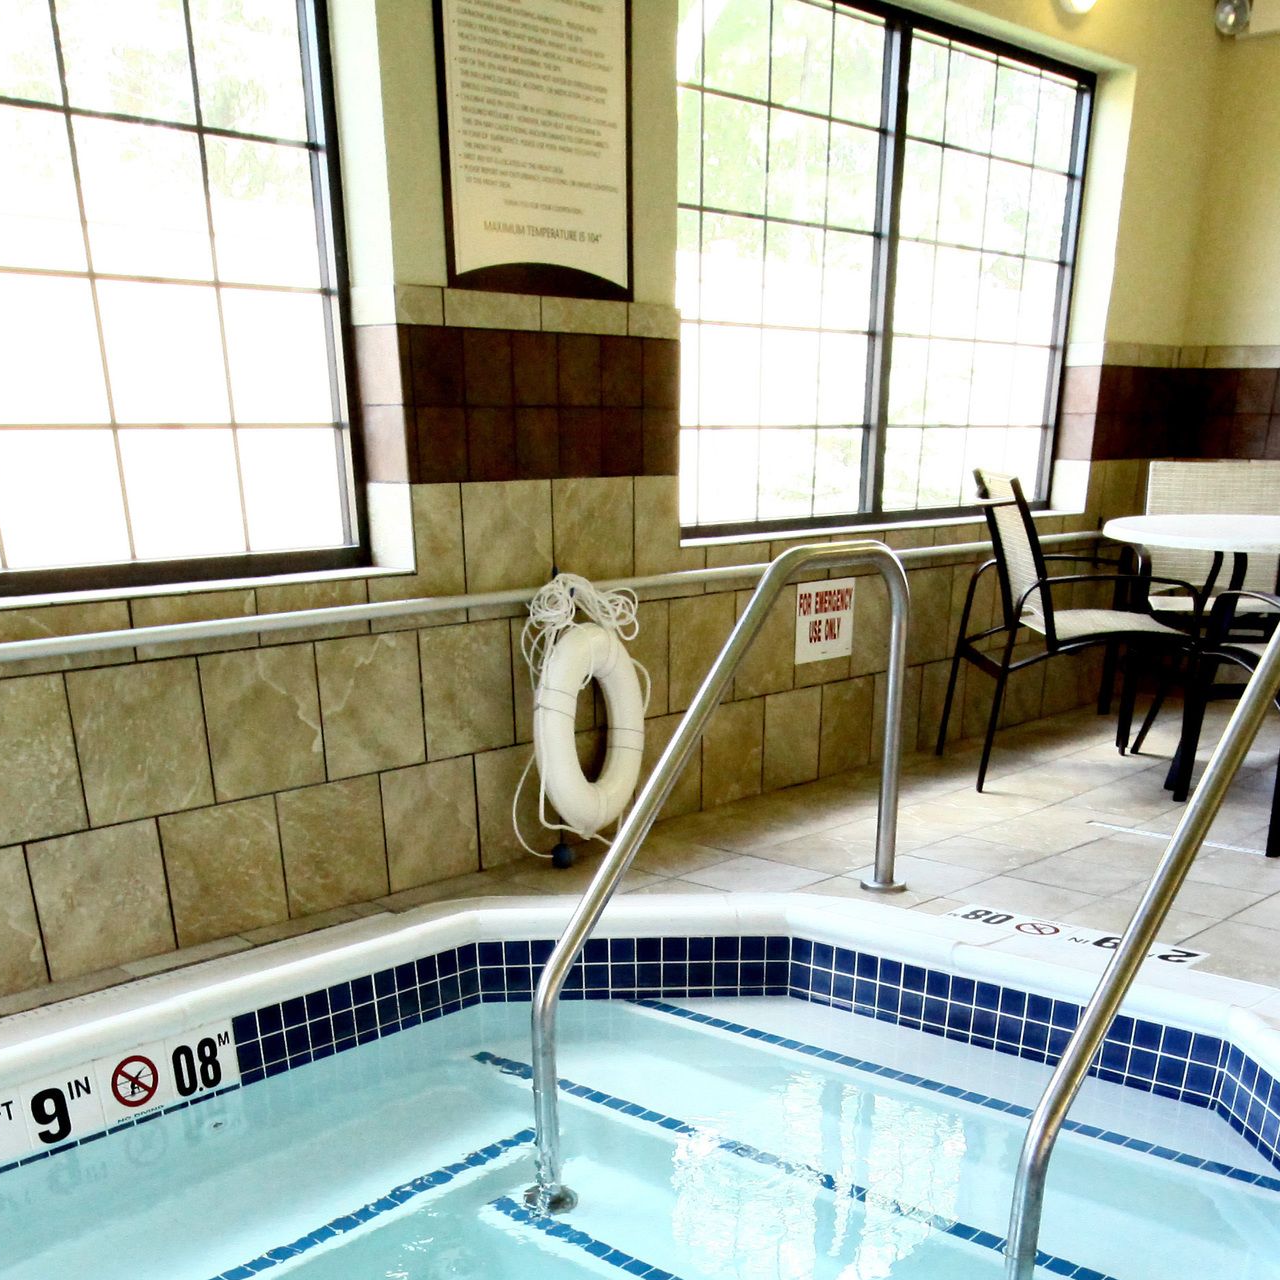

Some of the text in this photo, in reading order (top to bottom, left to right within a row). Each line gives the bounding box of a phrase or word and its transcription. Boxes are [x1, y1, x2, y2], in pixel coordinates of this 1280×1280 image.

[483, 220, 525, 235] MAXIMUM
[526, 225, 577, 242] TEMPERATURE
[578, 231, 586, 242] IS
[799, 588, 853, 616] FOR EMERGENCY
[809, 617, 841, 643] USE ONLY
[30, 1087, 72, 1144] 9
[67, 1076, 91, 1100] IN
